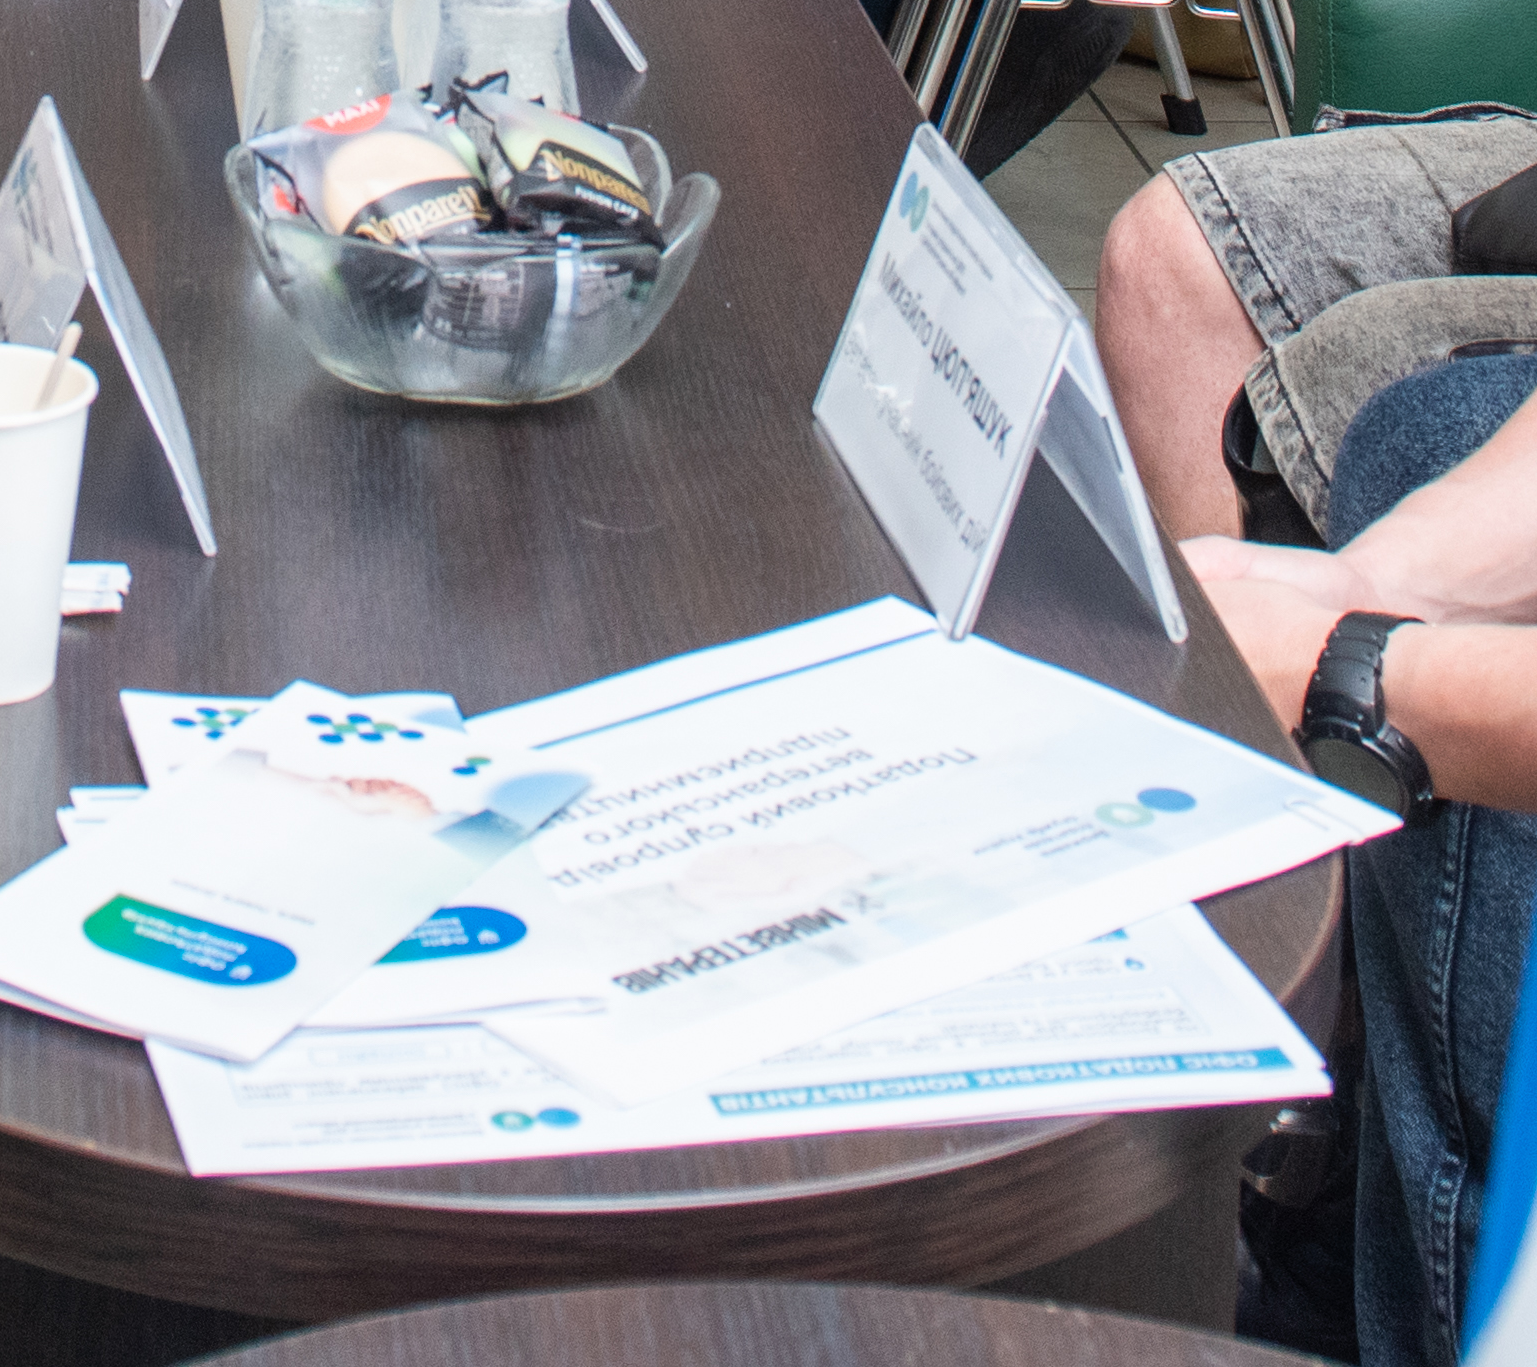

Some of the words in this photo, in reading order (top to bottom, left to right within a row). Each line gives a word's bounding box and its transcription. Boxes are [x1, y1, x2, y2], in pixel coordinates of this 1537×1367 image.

[322, 99, 381, 128] MAXI
[878, 251, 934, 348] Михайло
[553, 726, 852, 823] підприємництв
[583, 747, 874, 845] ветеранського
[740, 747, 978, 829] Податковий
[550, 821, 735, 890] супровід
[612, 906, 849, 995] МІНВЕТЕРАНІВ
[718, 1072, 969, 1112] КОНСУЛЬТАНТІВ
[978, 1058, 1171, 1088] ПОДАТКОВИХ
